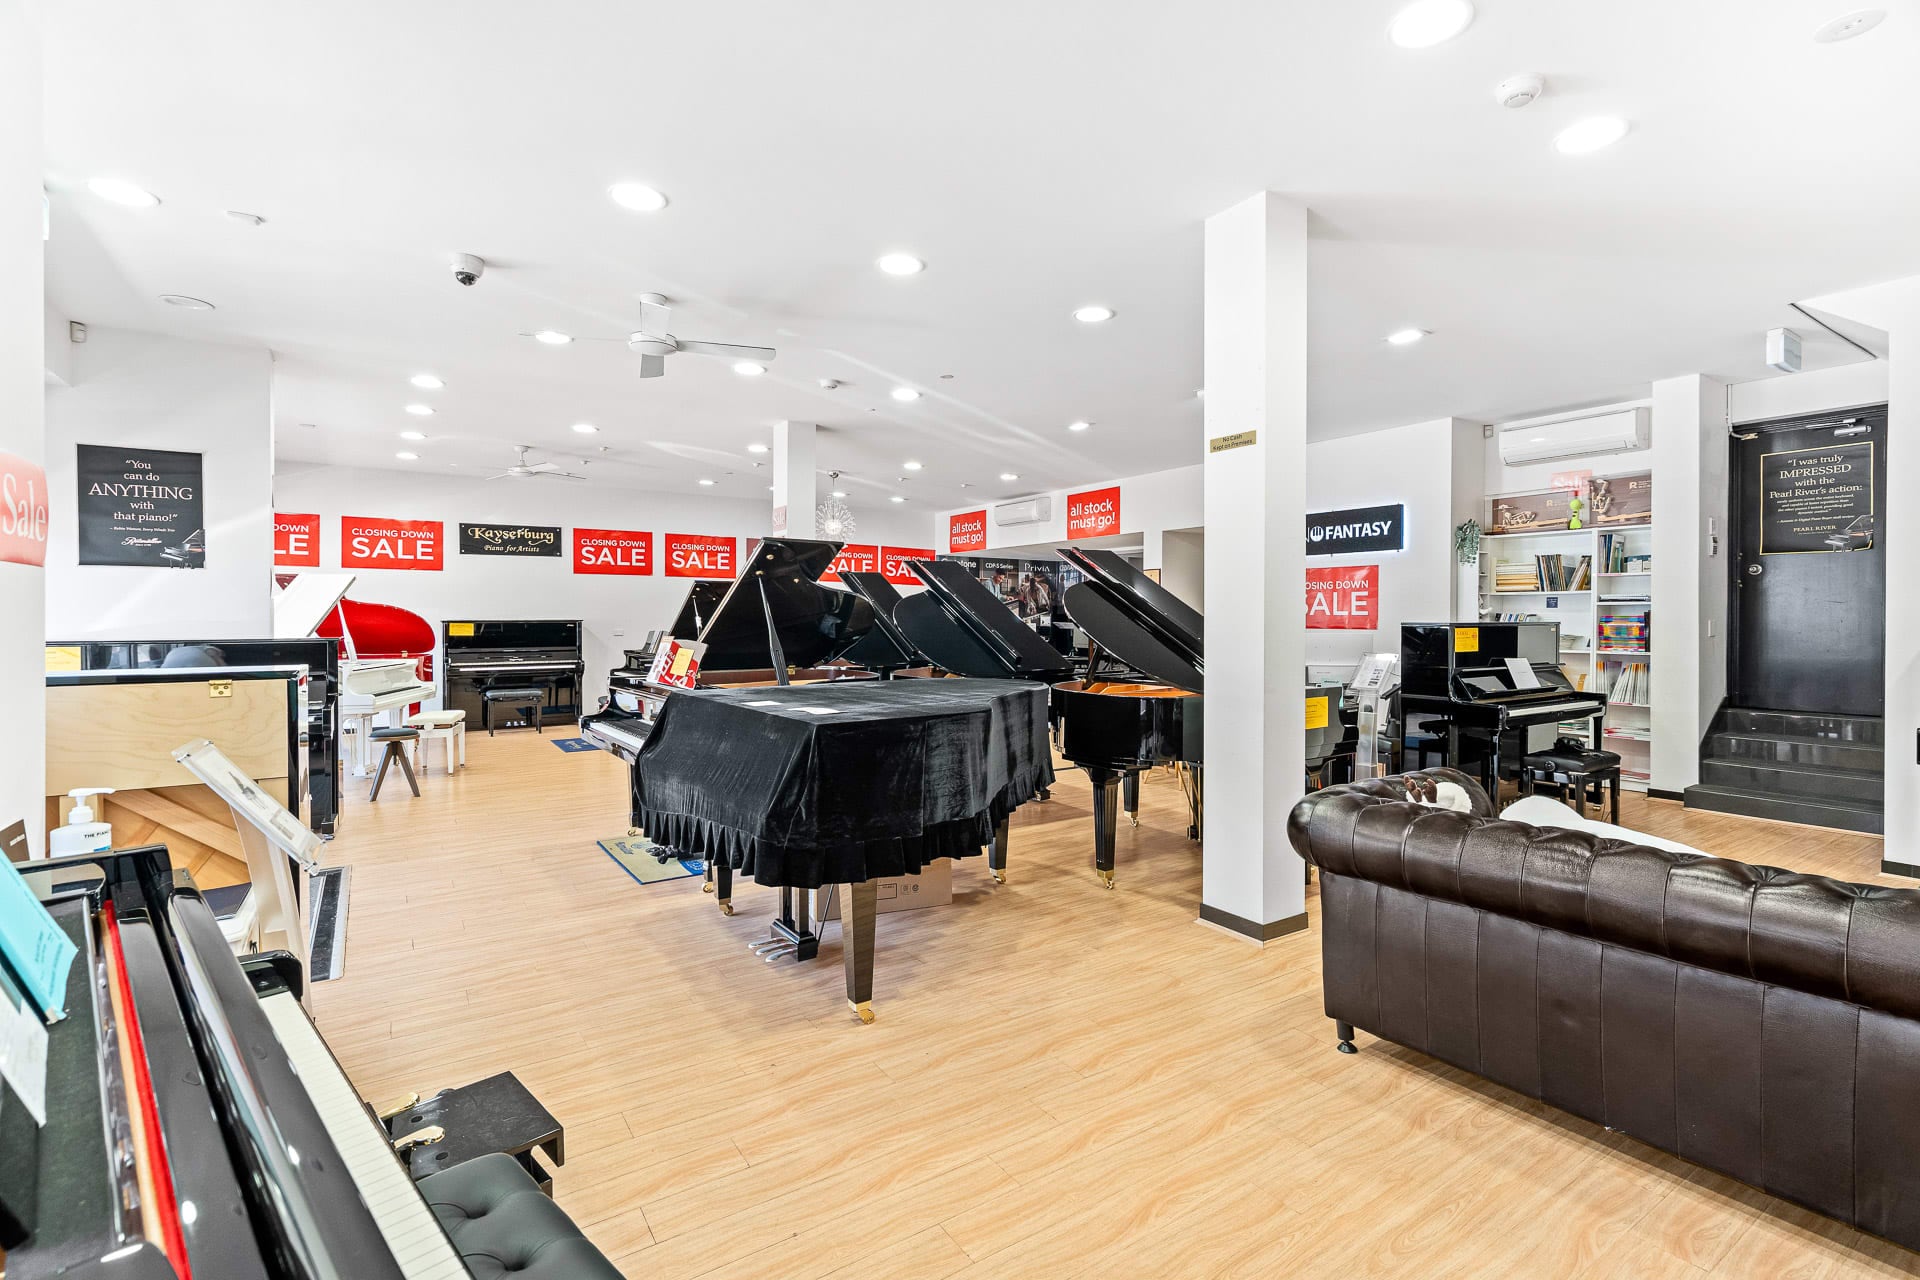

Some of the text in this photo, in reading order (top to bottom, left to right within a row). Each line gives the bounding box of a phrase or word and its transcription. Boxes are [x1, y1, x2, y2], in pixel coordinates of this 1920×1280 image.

[1798, 458, 1818, 466] was
[1820, 454, 1844, 464] truly
[146, 472, 160, 481] do
[1780, 463, 1852, 479] IMPRESSED
[1794, 477, 1835, 487] with the
[88, 482, 193, 500] ANYTHING
[1769, 489, 1792, 499] Pearl
[1828, 485, 1863, 493] action:
[3, 472, 46, 542] Sale
[130, 501, 154, 510] with
[1070, 498, 1113, 516] all stock
[113, 511, 136, 520] that
[1070, 512, 1116, 530] must go!
[274, 523, 309, 533] DOWN
[351, 527, 434, 539] CLOSING DOWN
[952, 520, 981, 534] all stock
[1325, 520, 1392, 540] FANTASY
[468, 527, 554, 546] Kayserburg
[580, 538, 646, 548] CLOSING DOWN
[951, 531, 984, 545] must go!
[351, 537, 434, 561] SALE
[504, 544, 517, 553] for
[672, 542, 730, 552] CLOSING DOWN
[580, 546, 646, 567] SALE
[672, 550, 730, 570] SALE
[1306, 579, 1369, 590] OSING DOWN
[1306, 591, 1369, 616] ALE
